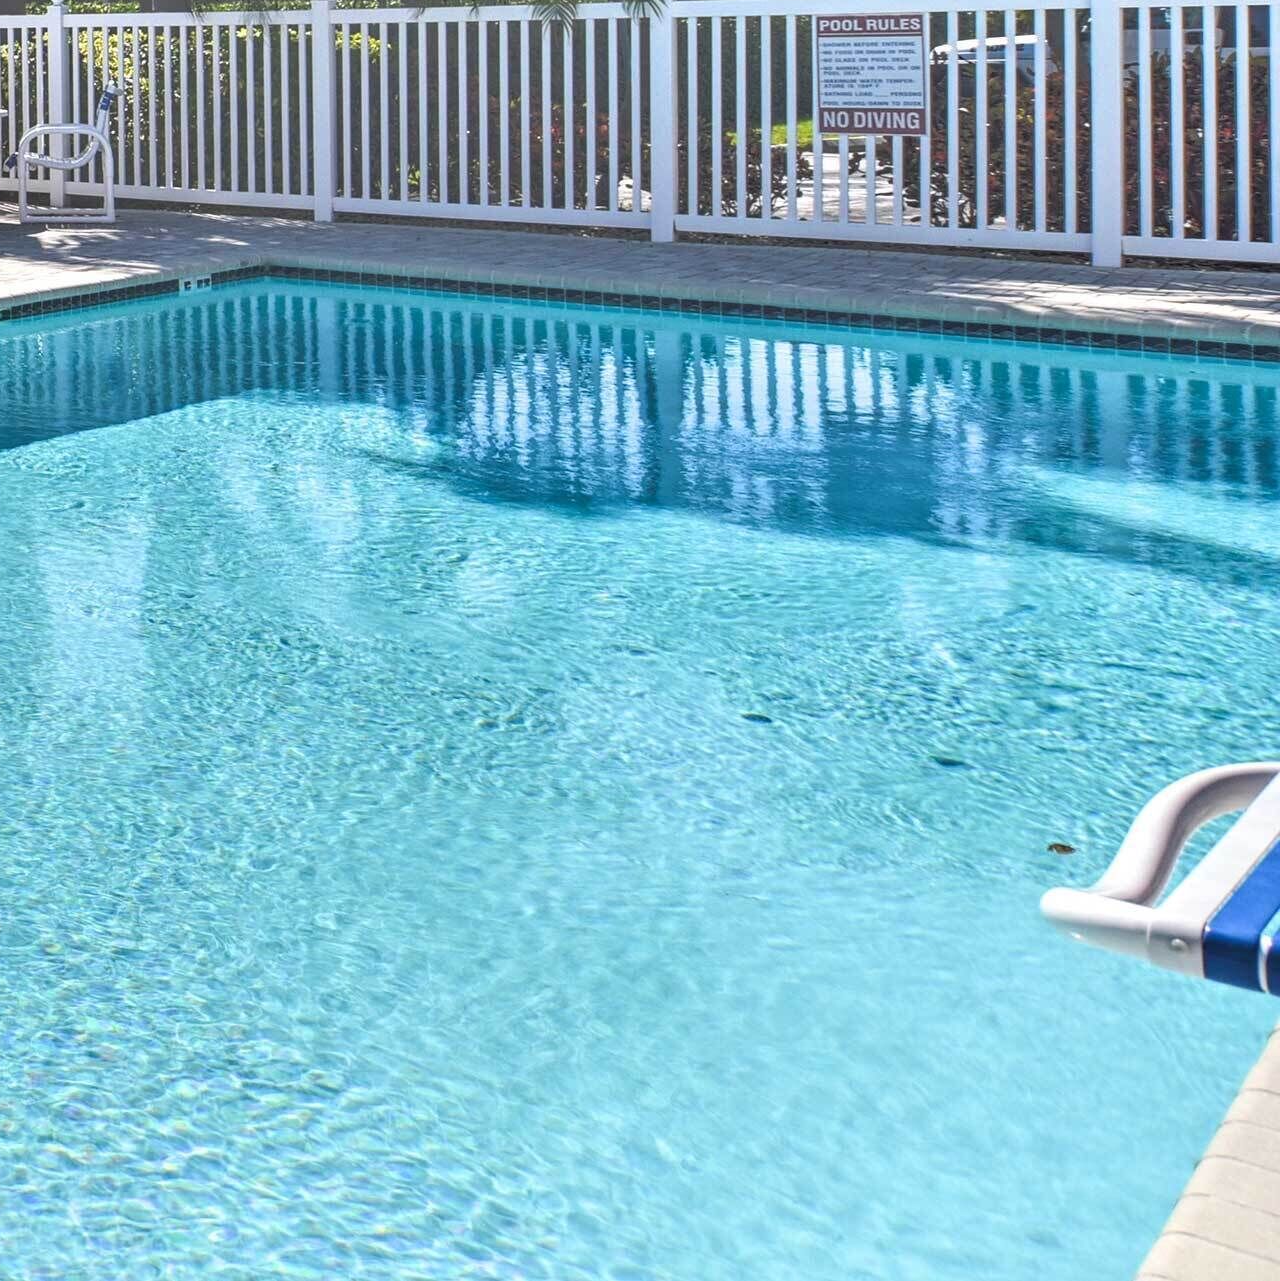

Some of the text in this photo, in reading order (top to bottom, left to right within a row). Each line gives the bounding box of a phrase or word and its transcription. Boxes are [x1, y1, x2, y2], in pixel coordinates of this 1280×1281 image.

[819, 18, 921, 32] POOL RULES
[823, 111, 920, 129] NO DIVING
